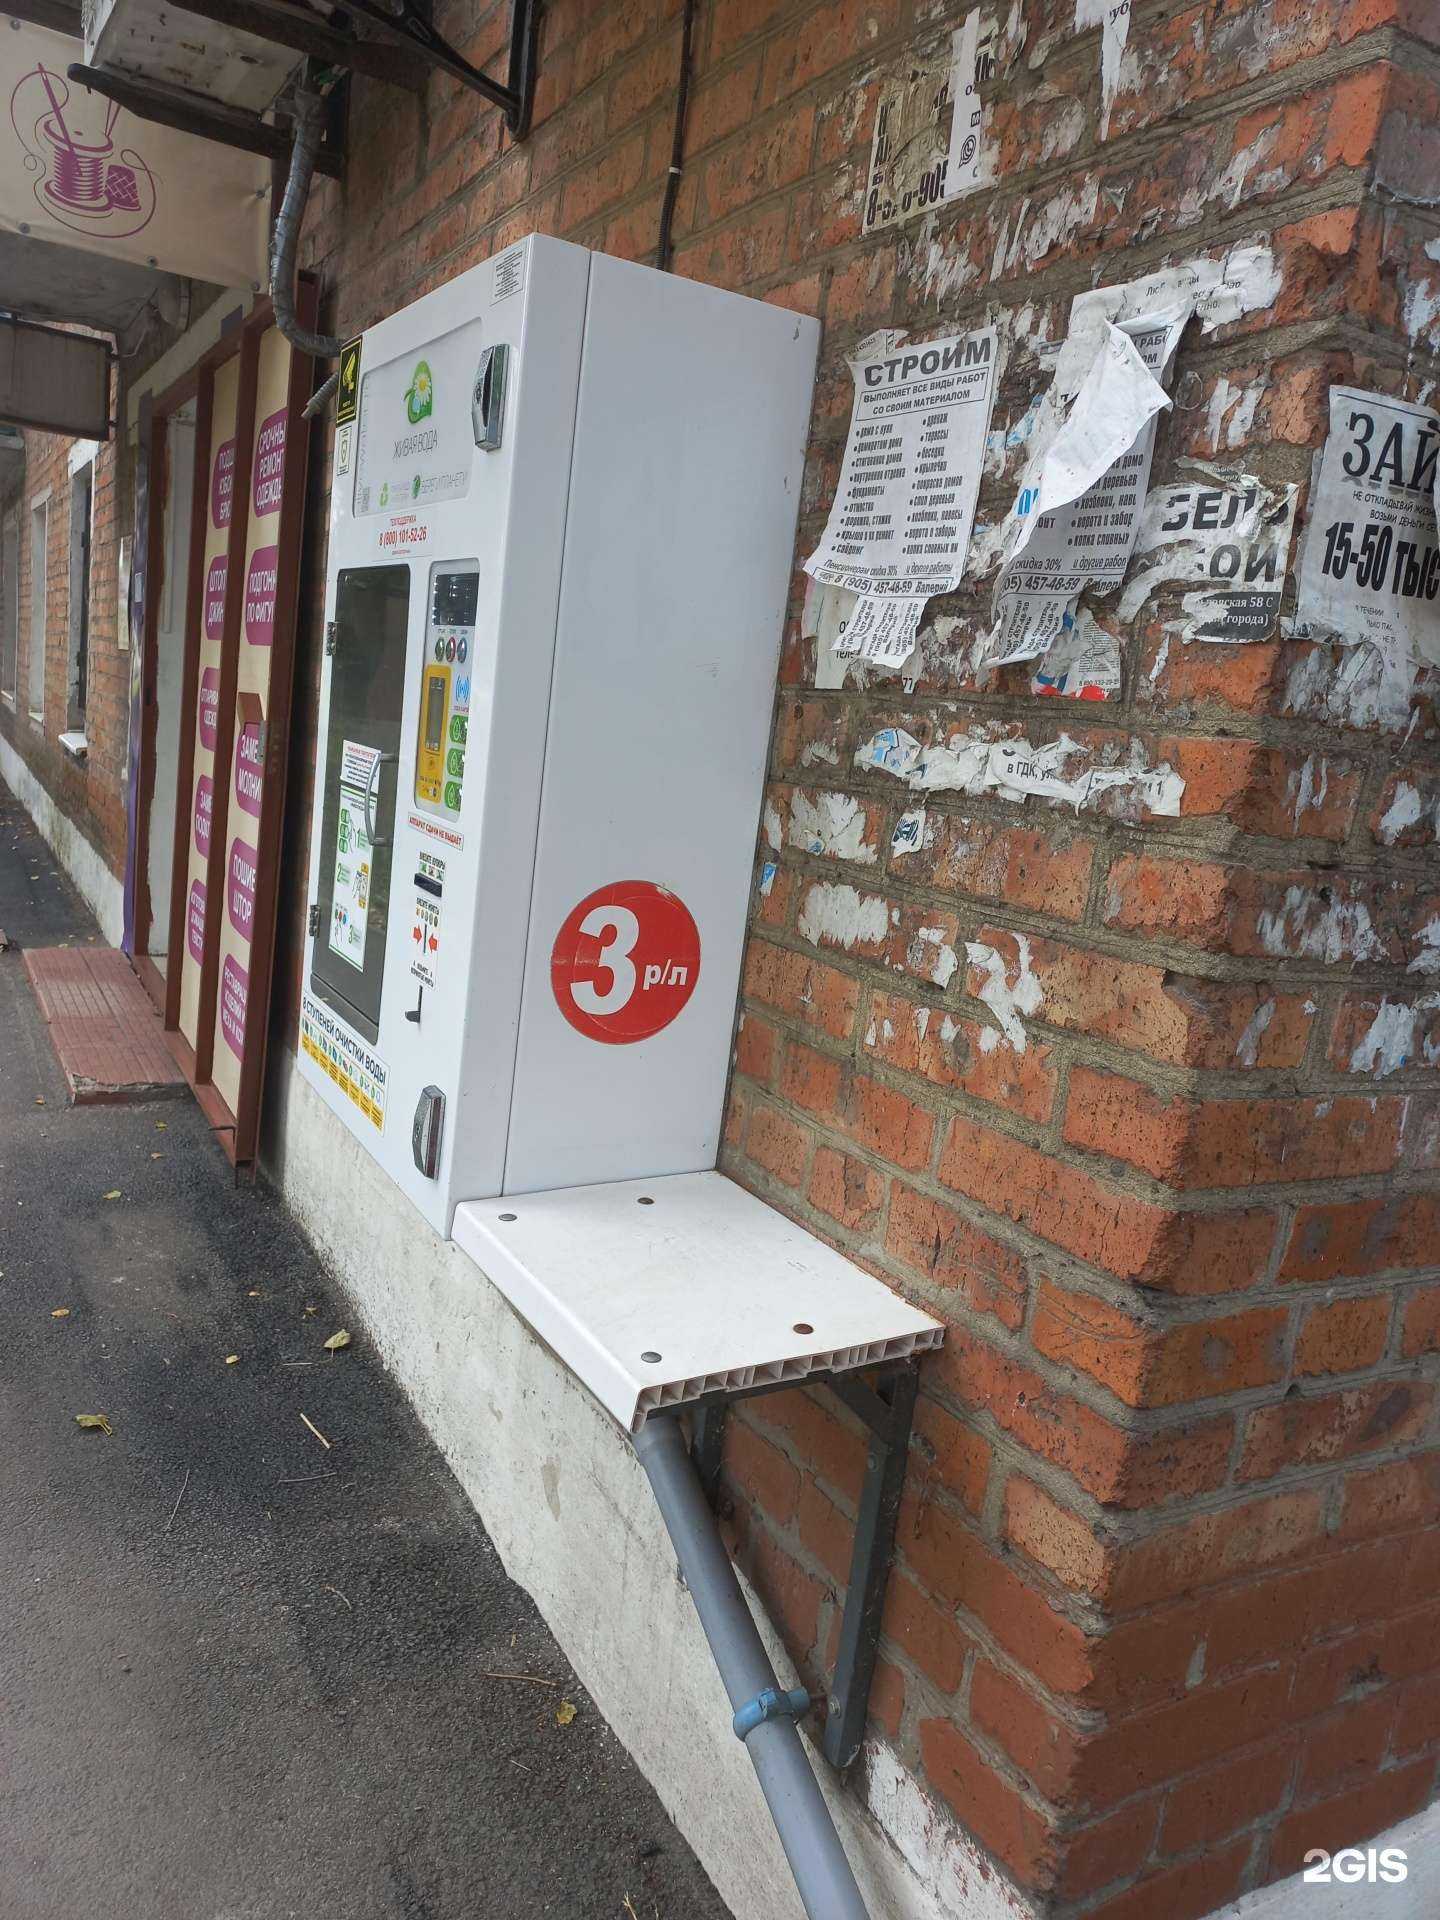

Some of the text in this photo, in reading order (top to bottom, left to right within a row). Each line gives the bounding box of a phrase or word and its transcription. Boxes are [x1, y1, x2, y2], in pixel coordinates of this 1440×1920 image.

[864, 337, 991, 387] СТРОИМ
[863, 372, 986, 403] ВЫПОЛНЯЕТ ВСЕ ВИДЫ РАБОТ
[873, 389, 970, 415] СО СВОИМ МАТЕРИАЛОМ
[1353, 490, 1363, 501] НЕ
[1364, 492, 1413, 513] ОТКЛАДЫВАЙ
[1369, 509, 1398, 523] ВОЗЬМИ
[1399, 515, 1425, 529] ДЕНЬГИ
[1044, 557, 1063, 571] 30%
[1322, 522, 1393, 592] 15-50
[834, 574, 843, 584] 8
[843, 576, 873, 594] (905)
[873, 580, 913, 594] 457-48-59
[914, 579, 949, 594] Валерий
[1025, 575, 1080, 591] 457-48-59
[1249, 596, 1264, 608] 58
[1016, 761, 1038, 780] ГДК,
[570, 904, 689, 1016] 3 р/л
[306, 1001, 335, 1034] СТУПЕНЕЙ
[335, 1027, 365, 1063] ОЧИСТКИ
[365, 1054, 387, 1085] ВОДЫ
